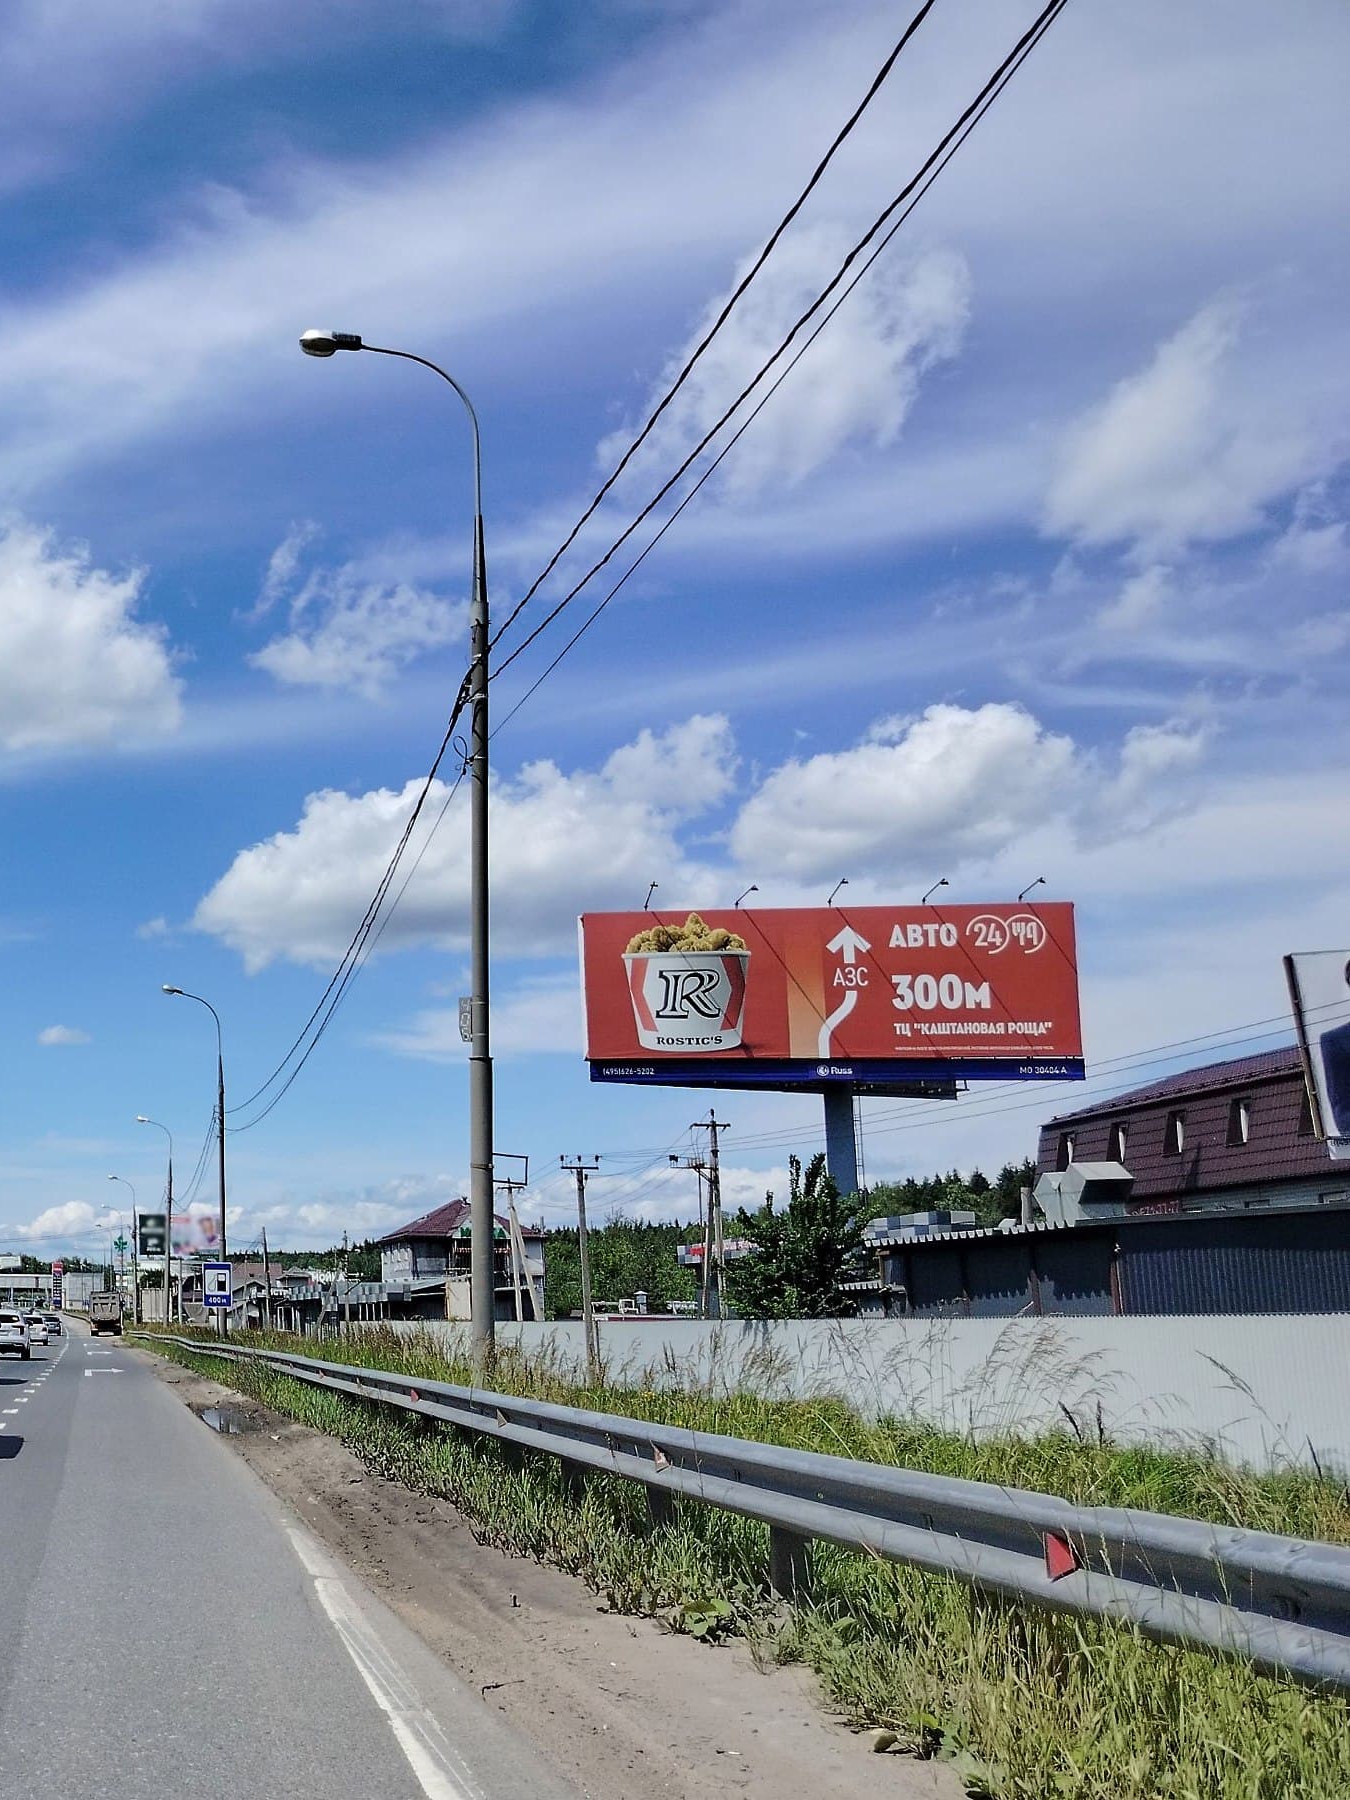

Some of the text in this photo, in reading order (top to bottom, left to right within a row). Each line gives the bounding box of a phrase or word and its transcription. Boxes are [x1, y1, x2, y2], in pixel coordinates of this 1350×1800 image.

[889, 923, 959, 948] АВТО
[832, 967, 869, 987] АЗС
[893, 1021, 1053, 1037] ТЦ "КАШТАНОВАЯ РОЩА"
[656, 1035, 723, 1046] ROSTIC'S
[830, 1066, 853, 1075] Russ
